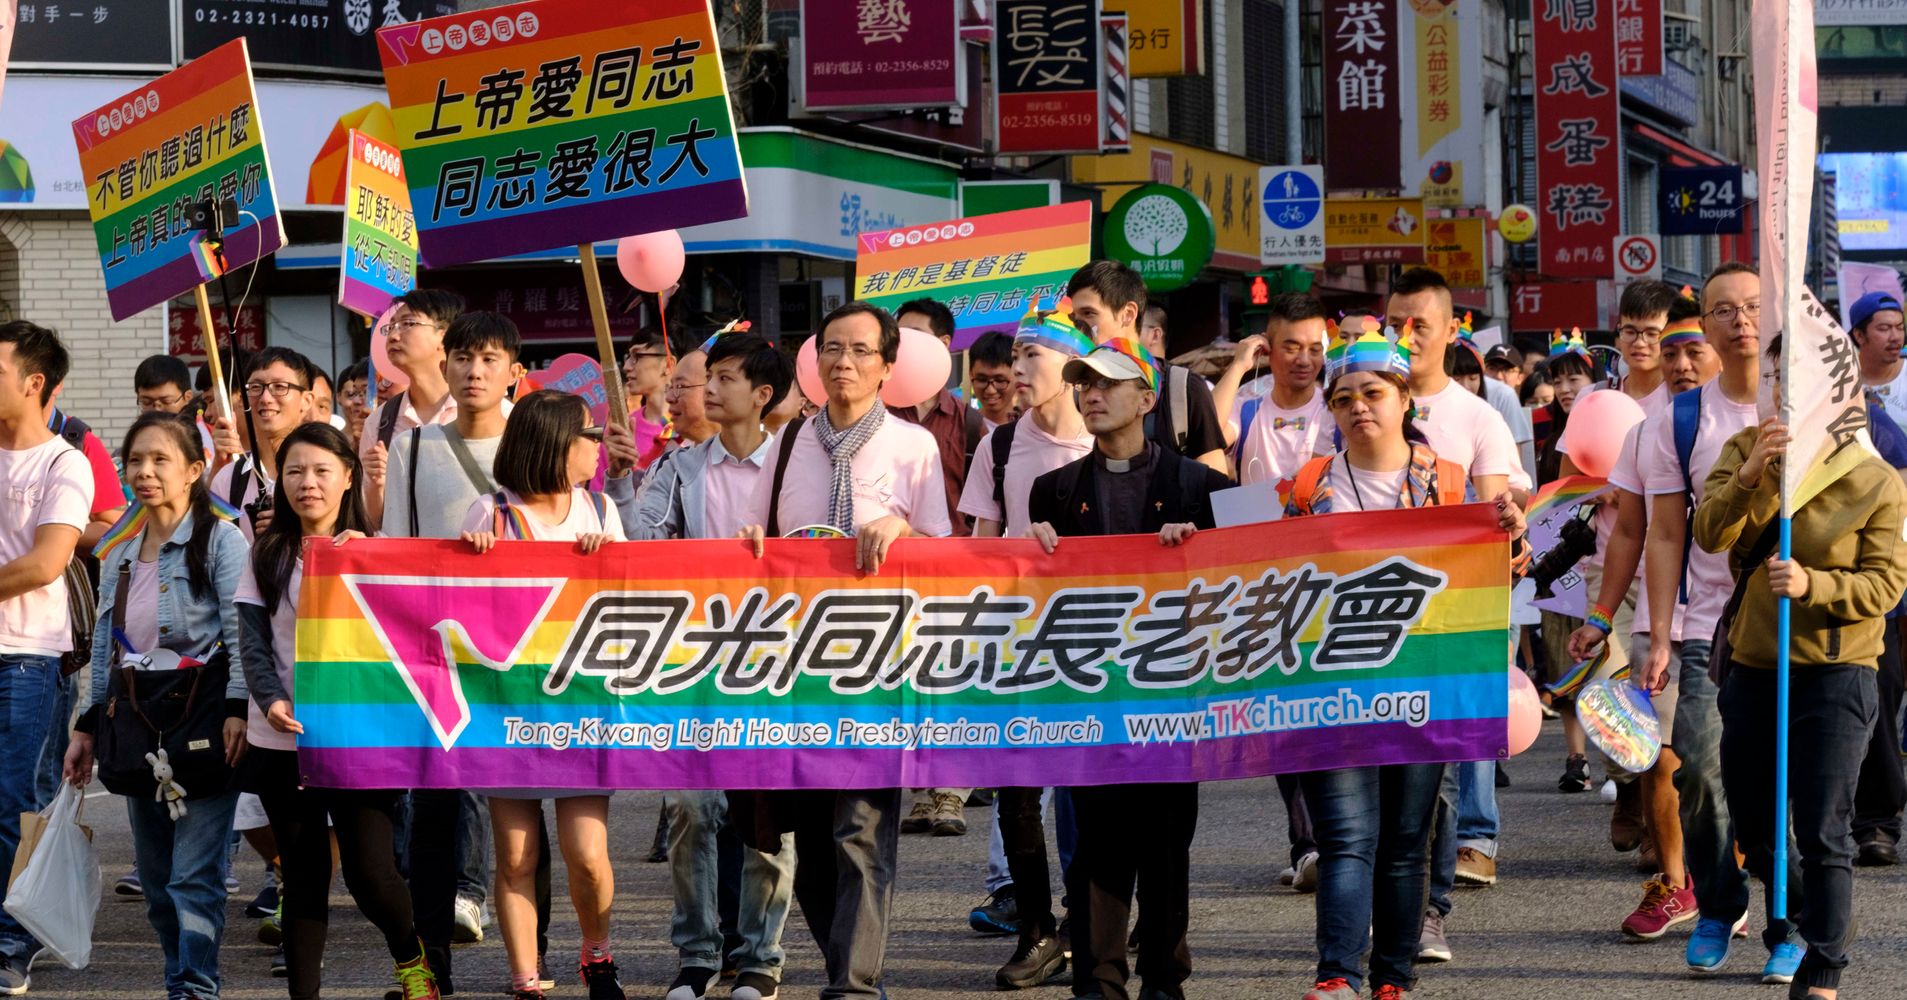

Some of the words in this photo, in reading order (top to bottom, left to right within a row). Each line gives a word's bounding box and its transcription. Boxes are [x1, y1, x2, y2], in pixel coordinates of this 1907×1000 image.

[19, 5, 109, 24] 對手一步
[194, 8, 330, 29] 02-2321-4057
[421, 11, 540, 54] 上帝愛同志
[856, 0, 911, 45] 藝
[1128, 29, 1171, 50] 分行
[1334, 2, 1387, 111] 菜館
[414, 37, 702, 141] 上帝愛同志
[1426, 24, 1449, 122] 公益彩券
[1003, 114, 1093, 129] 02-2356-8519
[95, 102, 250, 210] 不管你聽過什麼
[430, 118, 718, 223] 同志愛很大
[1700, 207, 1736, 219] hours
[1701, 180, 1736, 205] 24
[1264, 234, 1322, 249] 行人優先
[861, 251, 1028, 295] 我們是基督徒
[1516, 286, 1542, 313] 行
[544, 558, 1445, 695] 同光同志長老教會
[505, 717, 672, 751] Tong-Kwang
[677, 718, 744, 751] Light
[746, 718, 832, 746] House
[836, 717, 1000, 750] Presbyterian
[1004, 715, 1103, 746] Church
[1124, 688, 1429, 746] www.TKchurch.org
